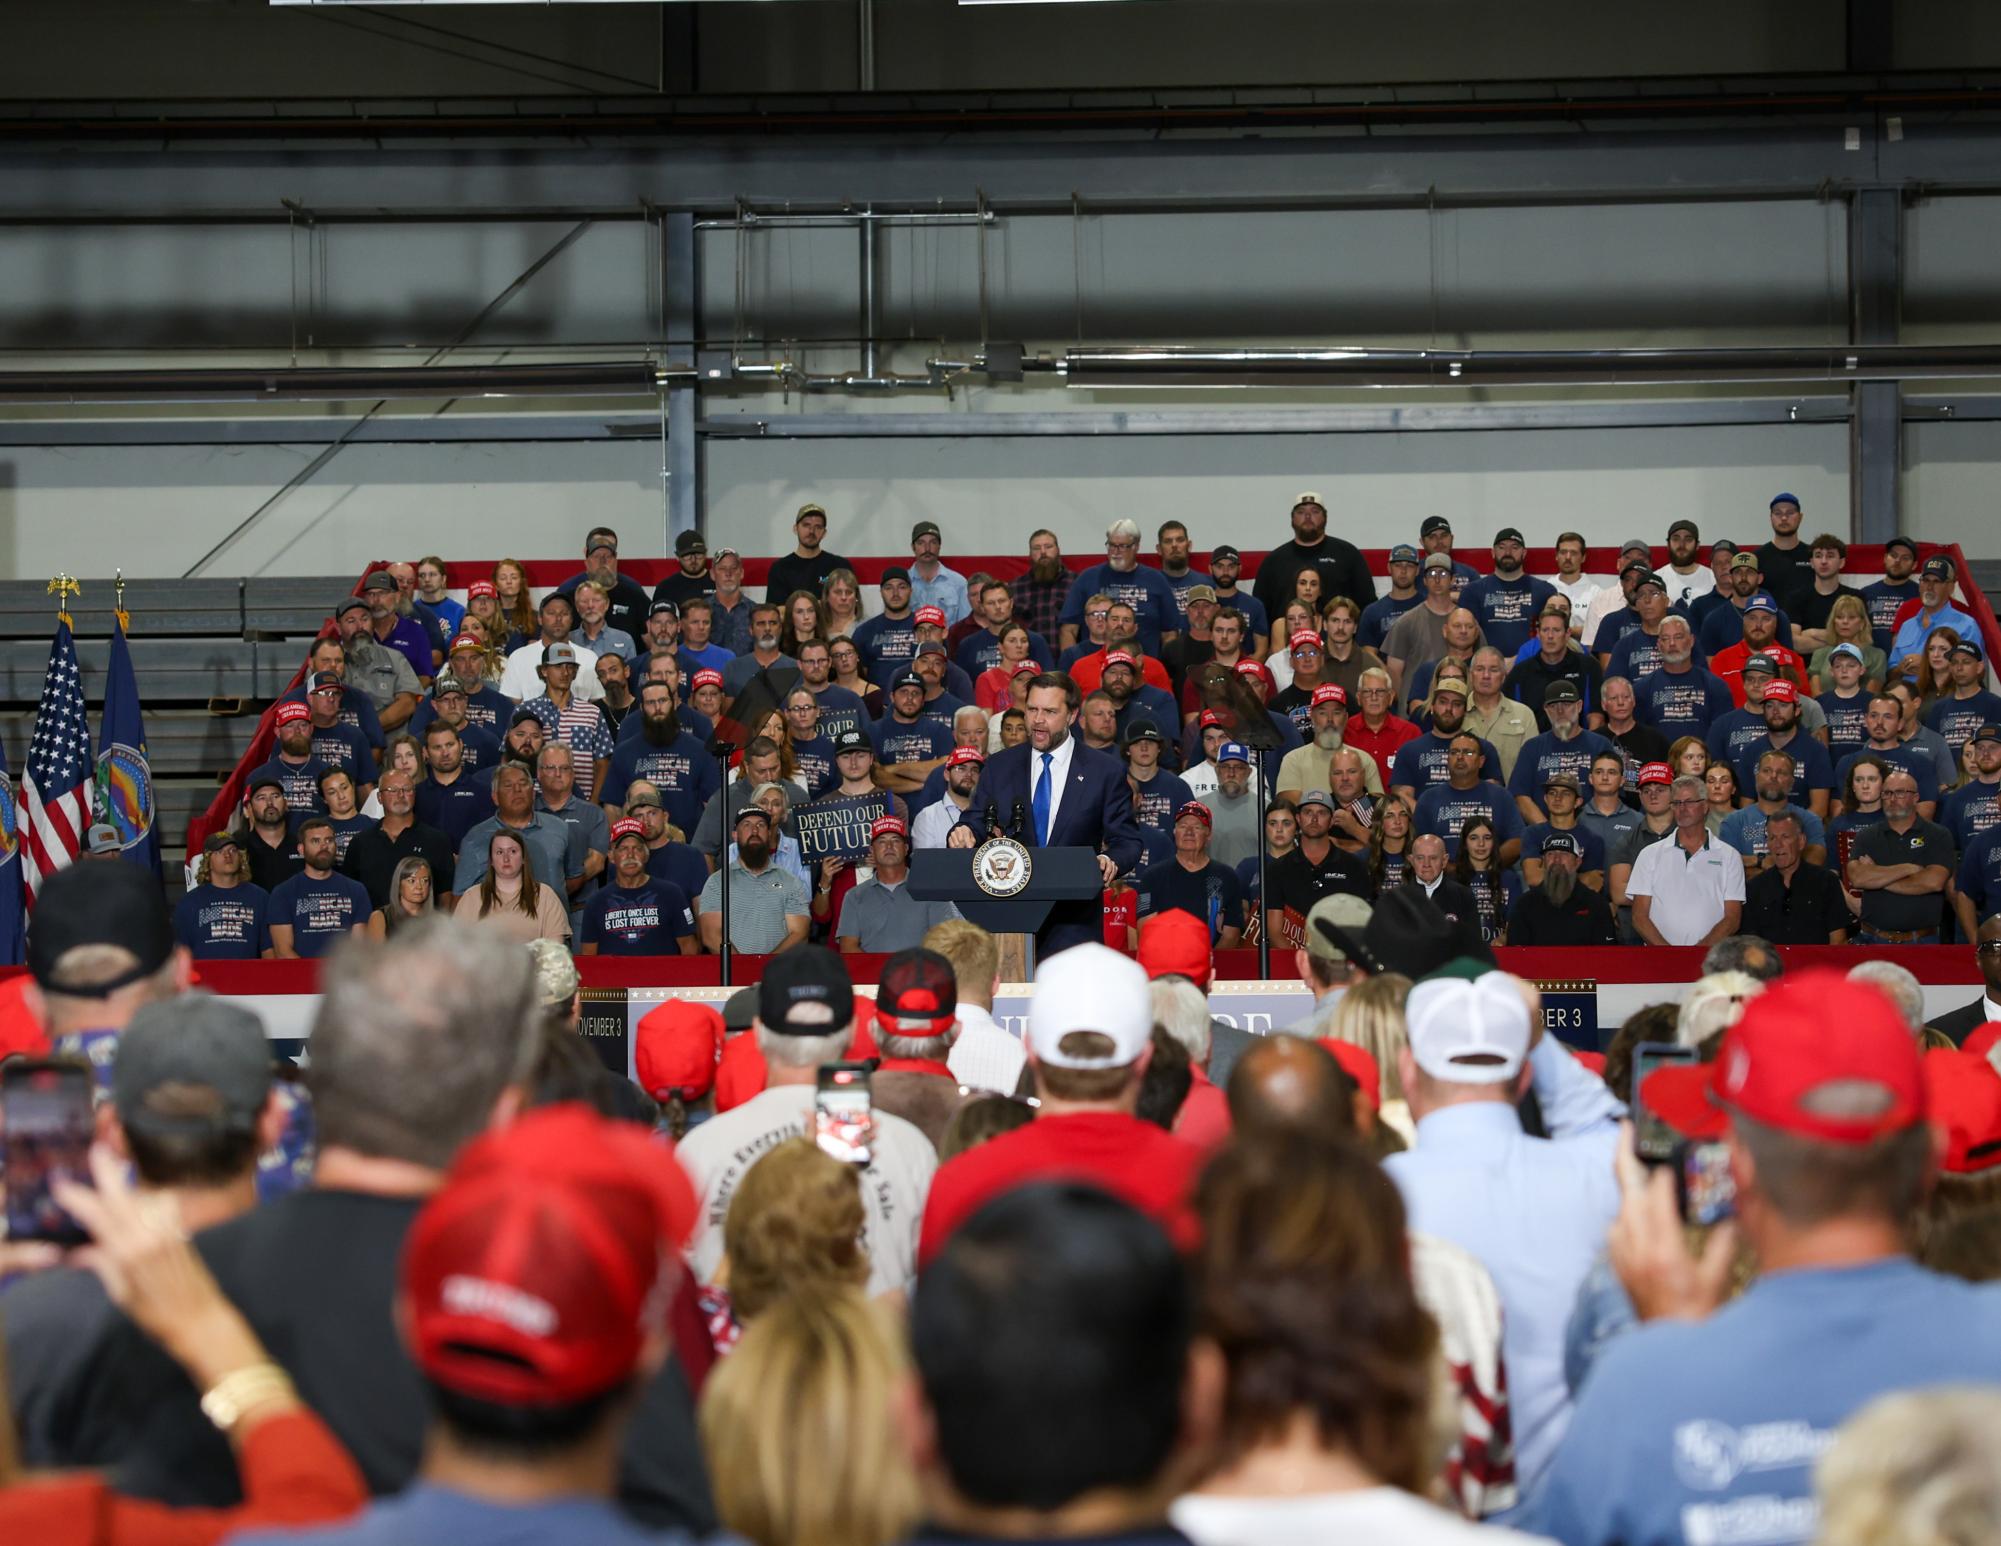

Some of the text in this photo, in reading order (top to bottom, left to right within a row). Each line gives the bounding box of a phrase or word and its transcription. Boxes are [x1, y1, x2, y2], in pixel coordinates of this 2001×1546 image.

[1927, 560, 1942, 569] CAT
[1019, 660, 1035, 668] USA
[635, 758, 690, 775] AMERICAN
[798, 804, 885, 831] DEFEND OUR
[800, 822, 873, 854] FUTUR
[296, 897, 352, 916] AMERICAN
[628, 909, 643, 918] ONCE
[198, 906, 254, 927] AMERICAN
[309, 911, 342, 928] MADE
[605, 920, 611, 930] IS
[612, 919, 628, 928] LOST
[211, 920, 243, 937] MADE
[1572, 1008, 1582, 1027] 3
[577, 1017, 622, 1036] OVEMBER 3
